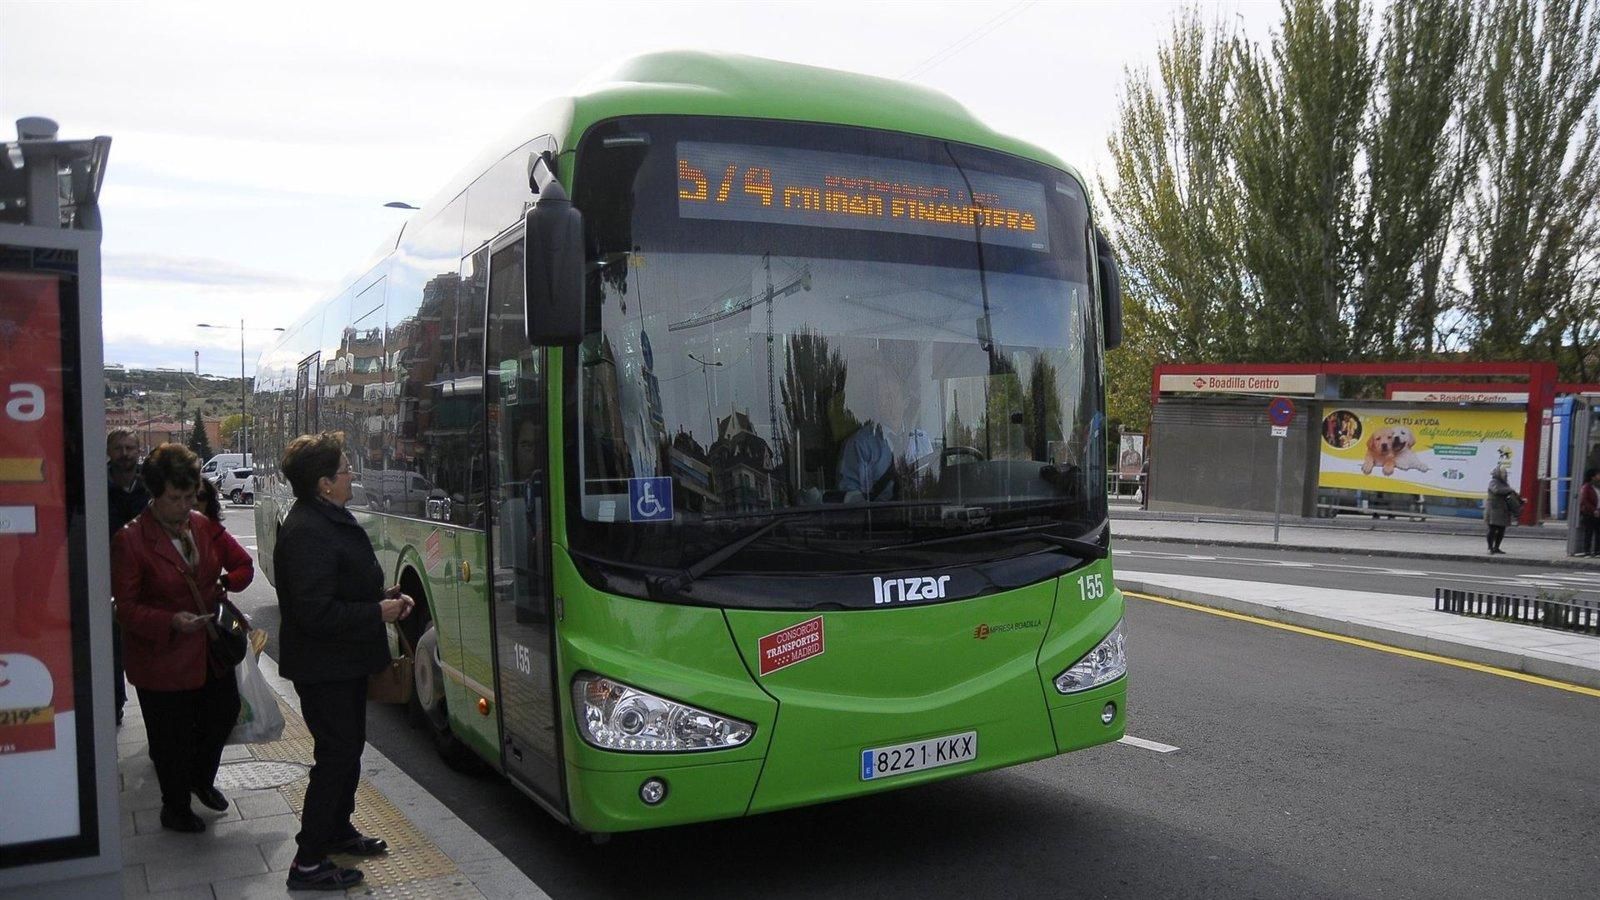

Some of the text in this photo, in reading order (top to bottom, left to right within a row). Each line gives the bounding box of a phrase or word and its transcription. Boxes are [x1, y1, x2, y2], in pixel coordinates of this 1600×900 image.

[1209, 377, 1280, 390] Boadilla Centro
[1384, 417, 1400, 425] CON
[1414, 418, 1440, 426] AYUDA
[873, 575, 951, 604] Irizar
[1077, 573, 1104, 601] 155
[766, 631, 820, 659] TRANSPORTES
[776, 621, 819, 644] CONSORCIO
[514, 643, 531, 675] 155
[791, 643, 820, 661] MADRID
[877, 735, 973, 773] 8221 KKX
